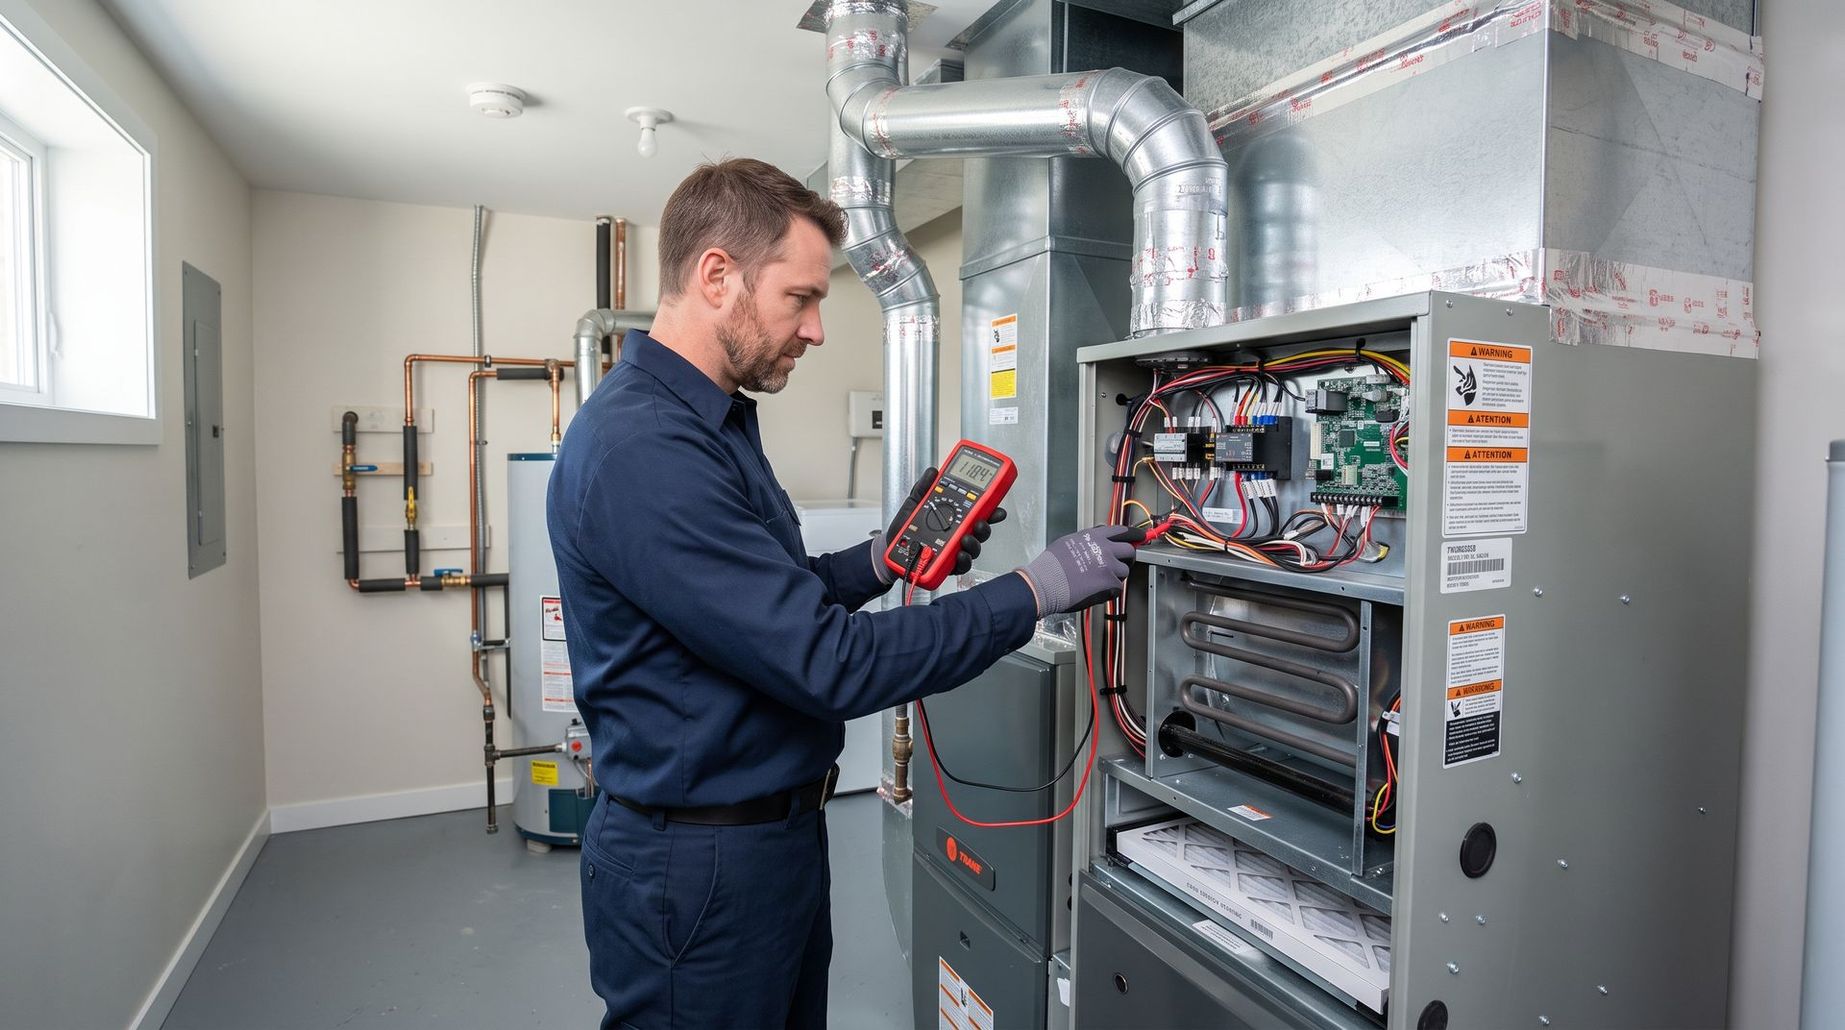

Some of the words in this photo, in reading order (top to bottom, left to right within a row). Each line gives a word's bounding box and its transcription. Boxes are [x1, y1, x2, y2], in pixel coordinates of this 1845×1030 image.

[1478, 347, 1513, 359] WARNING
[1472, 450, 1512, 459] ATTENTION
[1465, 620, 1495, 630] WARNING
[959, 850, 983, 875] TRANE
